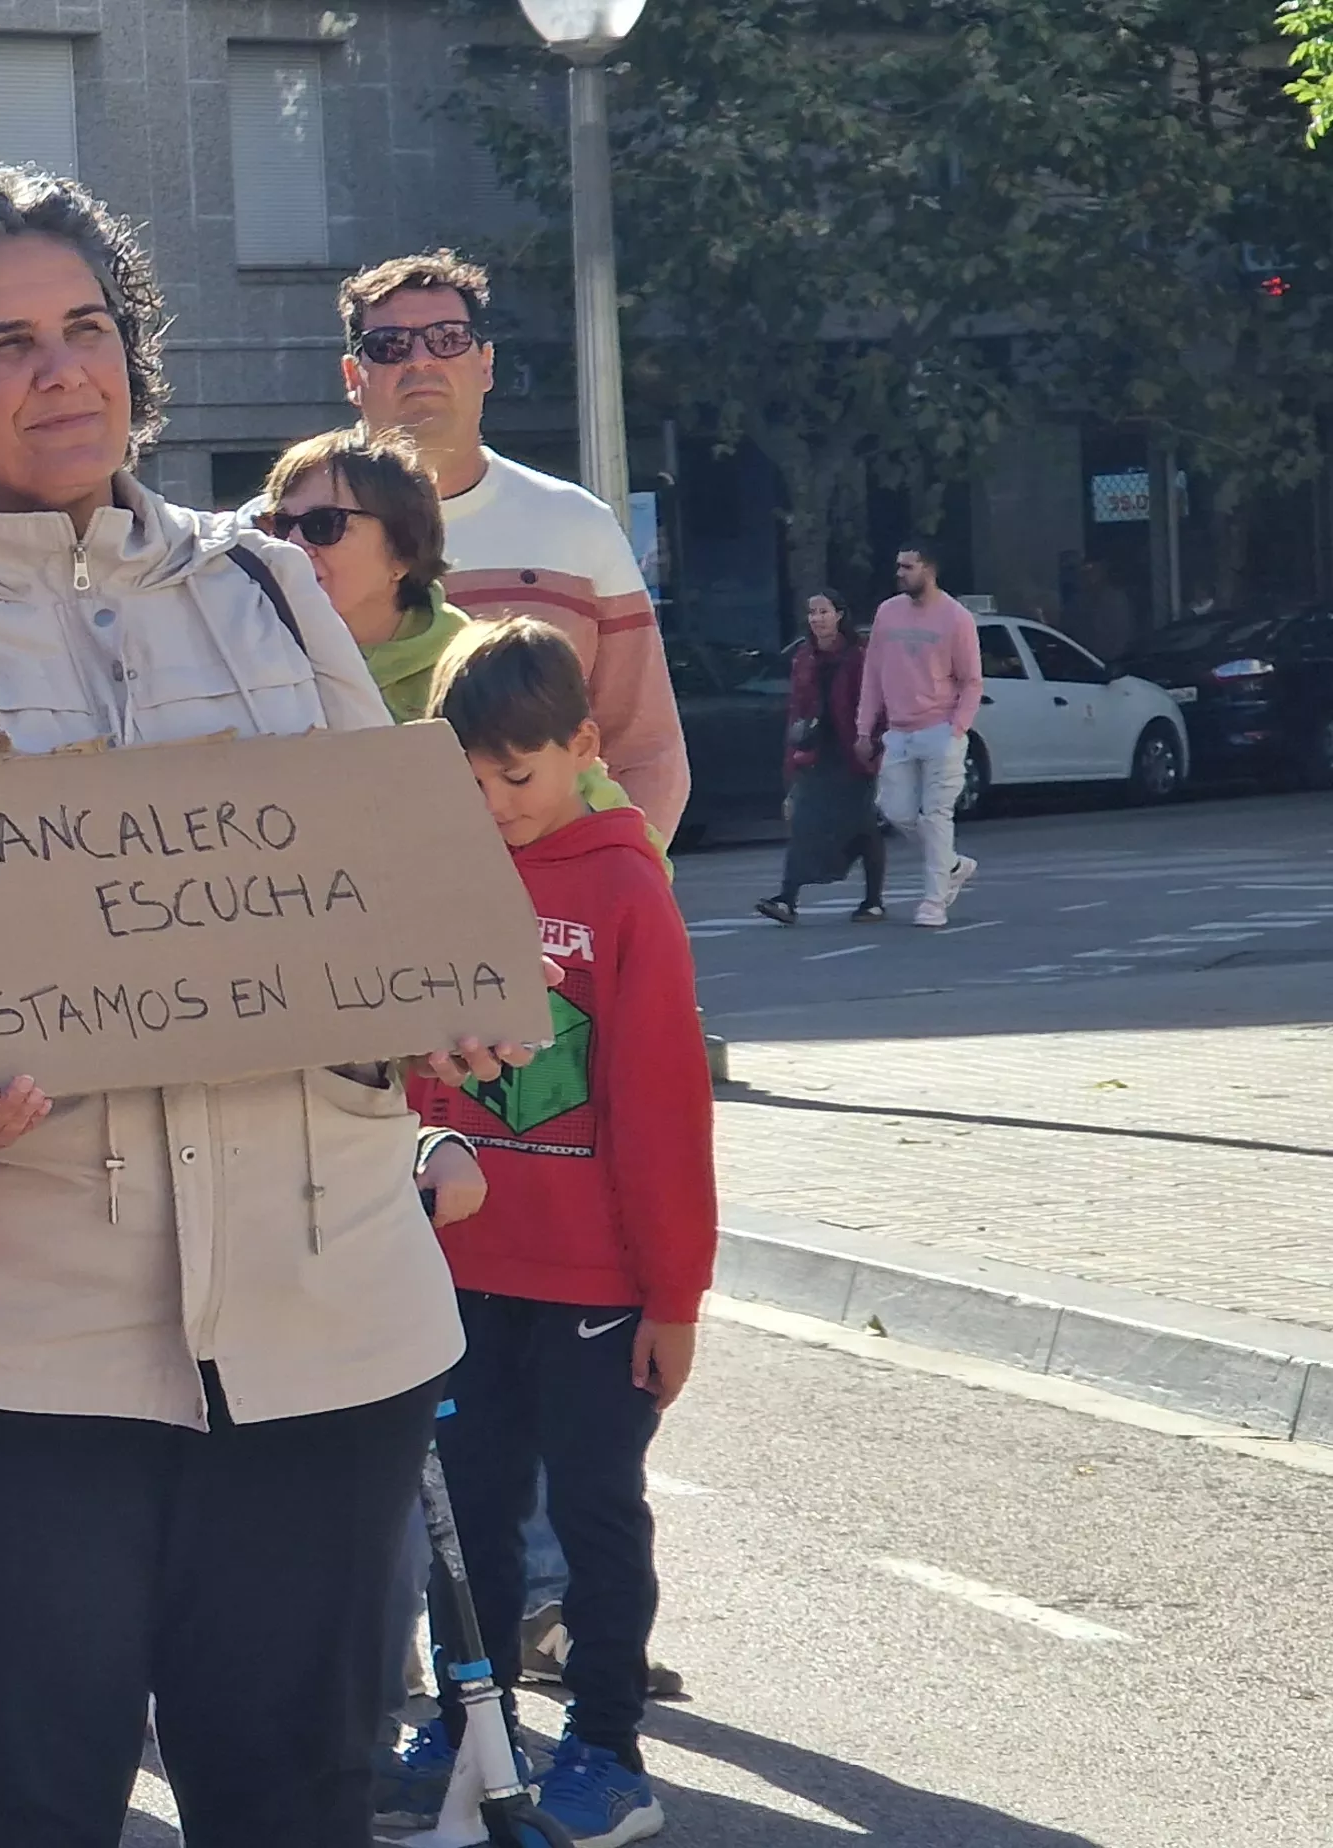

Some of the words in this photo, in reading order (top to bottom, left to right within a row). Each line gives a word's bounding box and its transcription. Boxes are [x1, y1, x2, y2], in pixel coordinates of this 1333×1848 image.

[95, 868, 367, 937] ESCUCHA
[231, 963, 288, 1019] EN
[324, 962, 506, 1011] LUCHA
